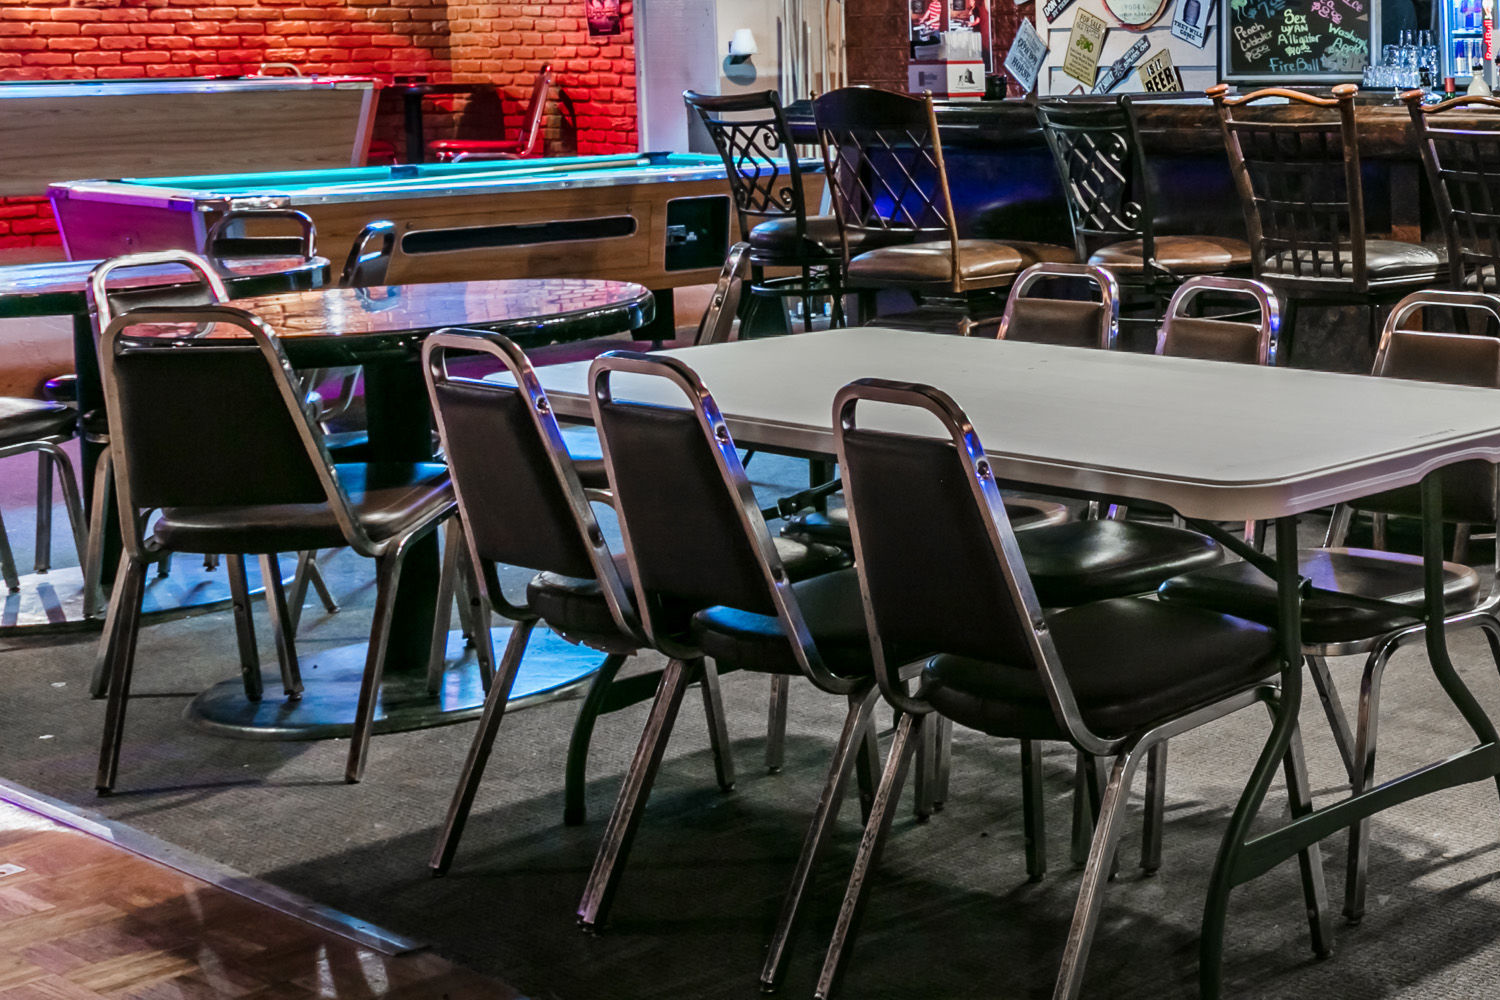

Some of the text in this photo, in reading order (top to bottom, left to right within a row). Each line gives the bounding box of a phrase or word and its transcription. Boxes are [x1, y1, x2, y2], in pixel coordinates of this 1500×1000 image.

[1283, 8, 1307, 24] Sex
[1233, 22, 1266, 41] Peach
[1146, 59, 1163, 77] IS IT
[1145, 66, 1177, 92] BEER
